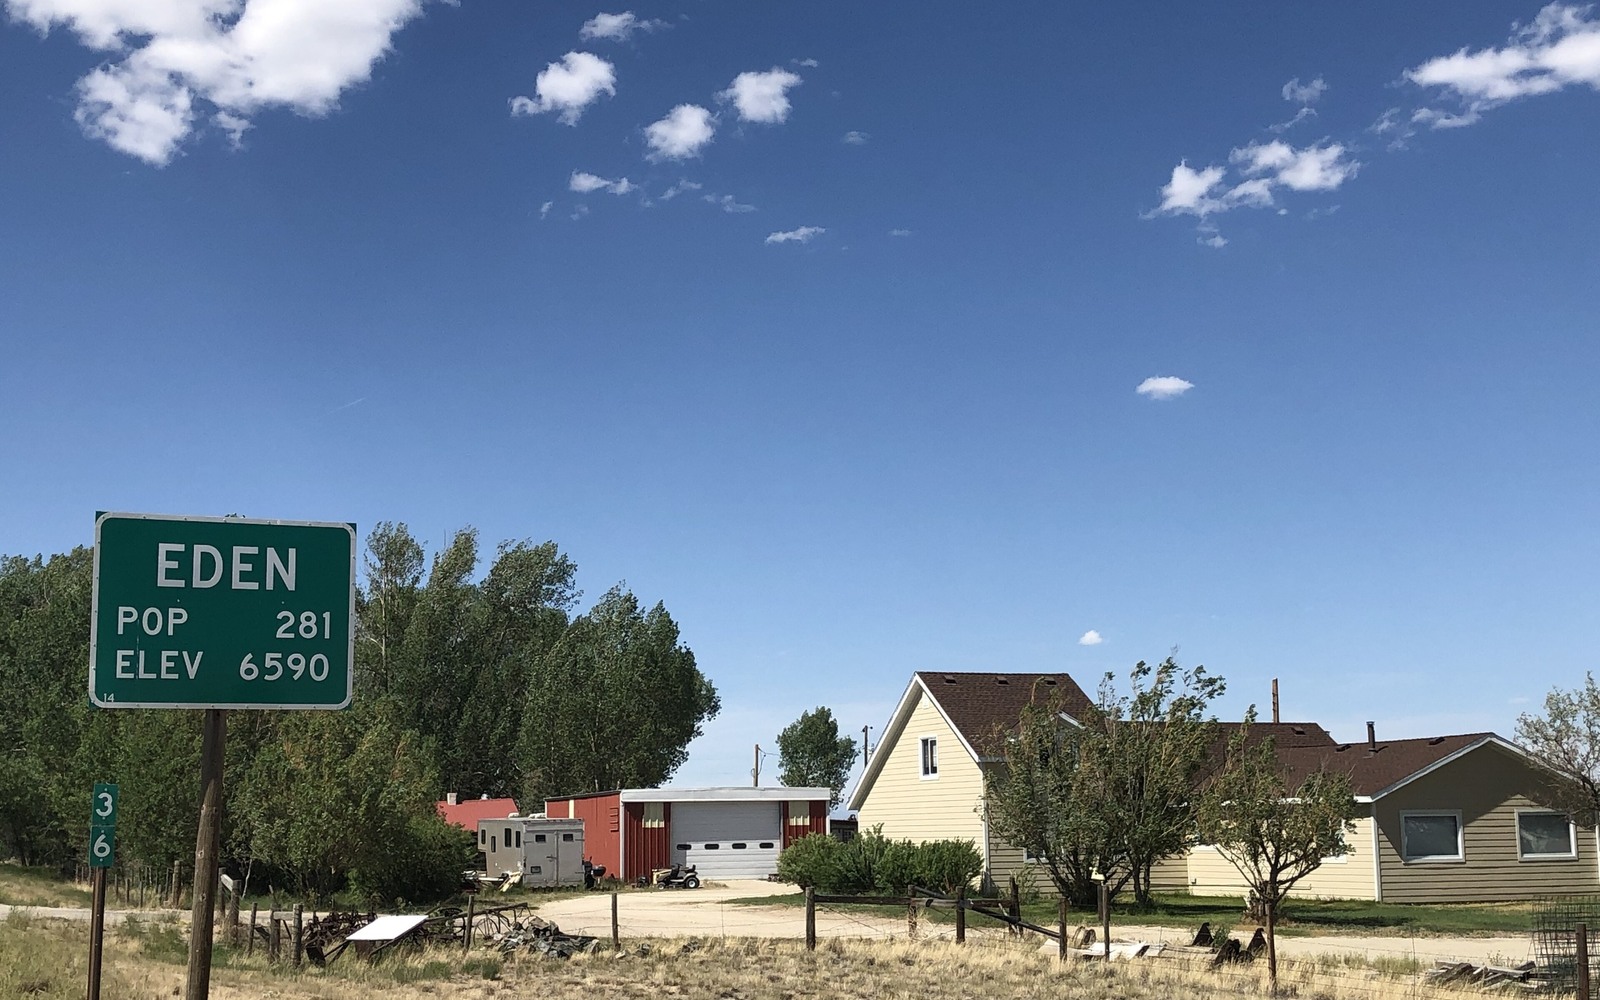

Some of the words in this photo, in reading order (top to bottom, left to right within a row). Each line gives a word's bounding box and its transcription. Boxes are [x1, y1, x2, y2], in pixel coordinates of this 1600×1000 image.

[157, 542, 296, 591] EDEN
[117, 606, 188, 636] POP
[275, 610, 331, 639] 281
[116, 649, 204, 679] ELEV
[239, 652, 329, 682] 6590
[103, 693, 115, 703] 14
